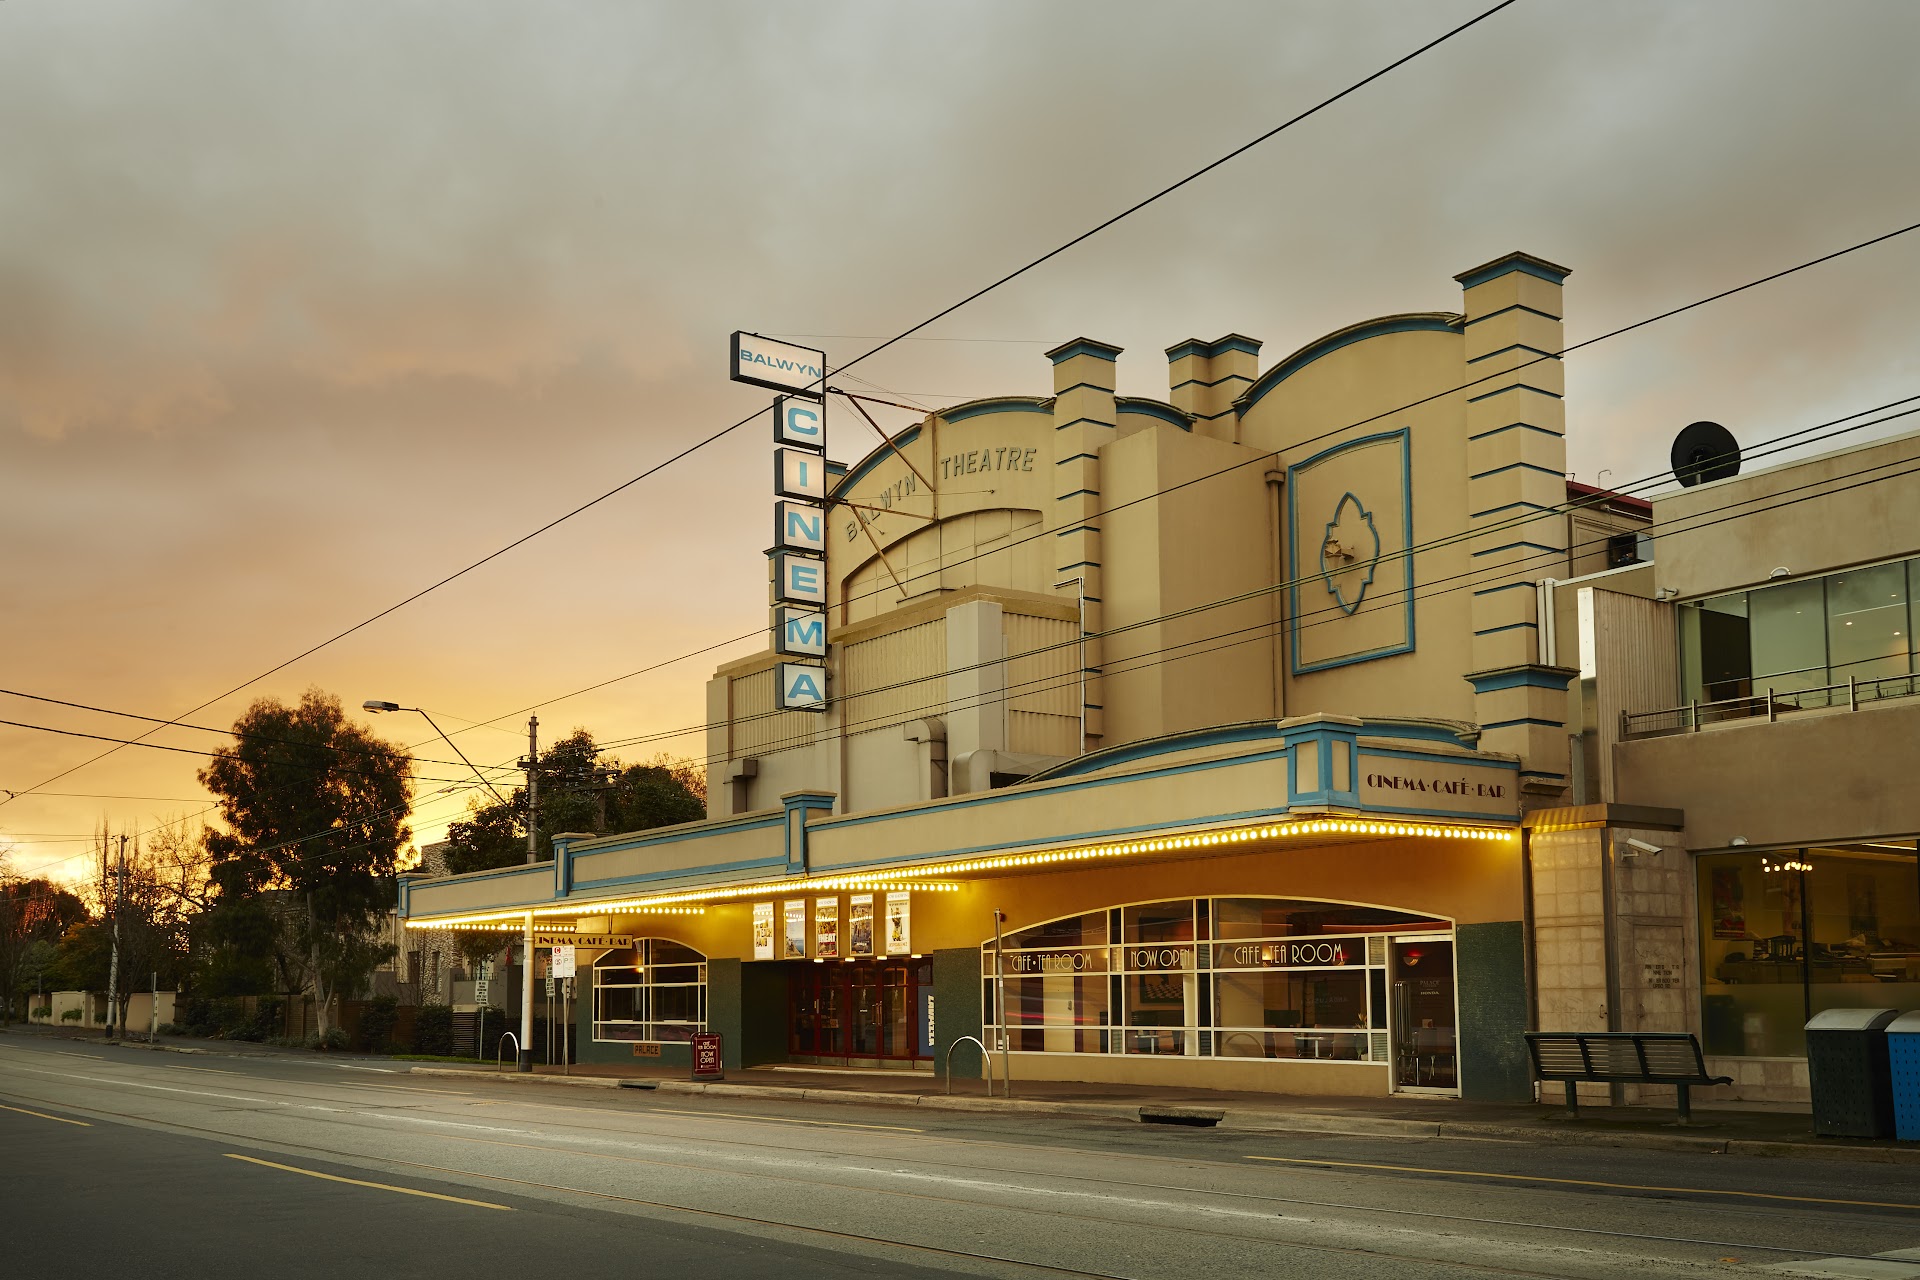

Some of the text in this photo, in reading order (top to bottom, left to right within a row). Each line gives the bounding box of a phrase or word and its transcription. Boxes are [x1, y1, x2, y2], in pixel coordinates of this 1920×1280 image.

[740, 349, 822, 378] BALWYN
[845, 447, 1037, 543] BALWYN THEATRE
[787, 407, 823, 701] CINEMA
[1367, 773, 1506, 799] CINEMA CAFÉ BAR
[578, 936, 605, 945] CAFÉ
[609, 938, 631, 946] BAR
[1012, 952, 1093, 971] CAFE TEA ROOM
[1130, 949, 1190, 968] NOW OPEN
[1234, 944, 1344, 965] CAFE TEA ROOM
[927, 994, 935, 1047] LAVAZZA
[634, 1045, 659, 1055] PALACE
